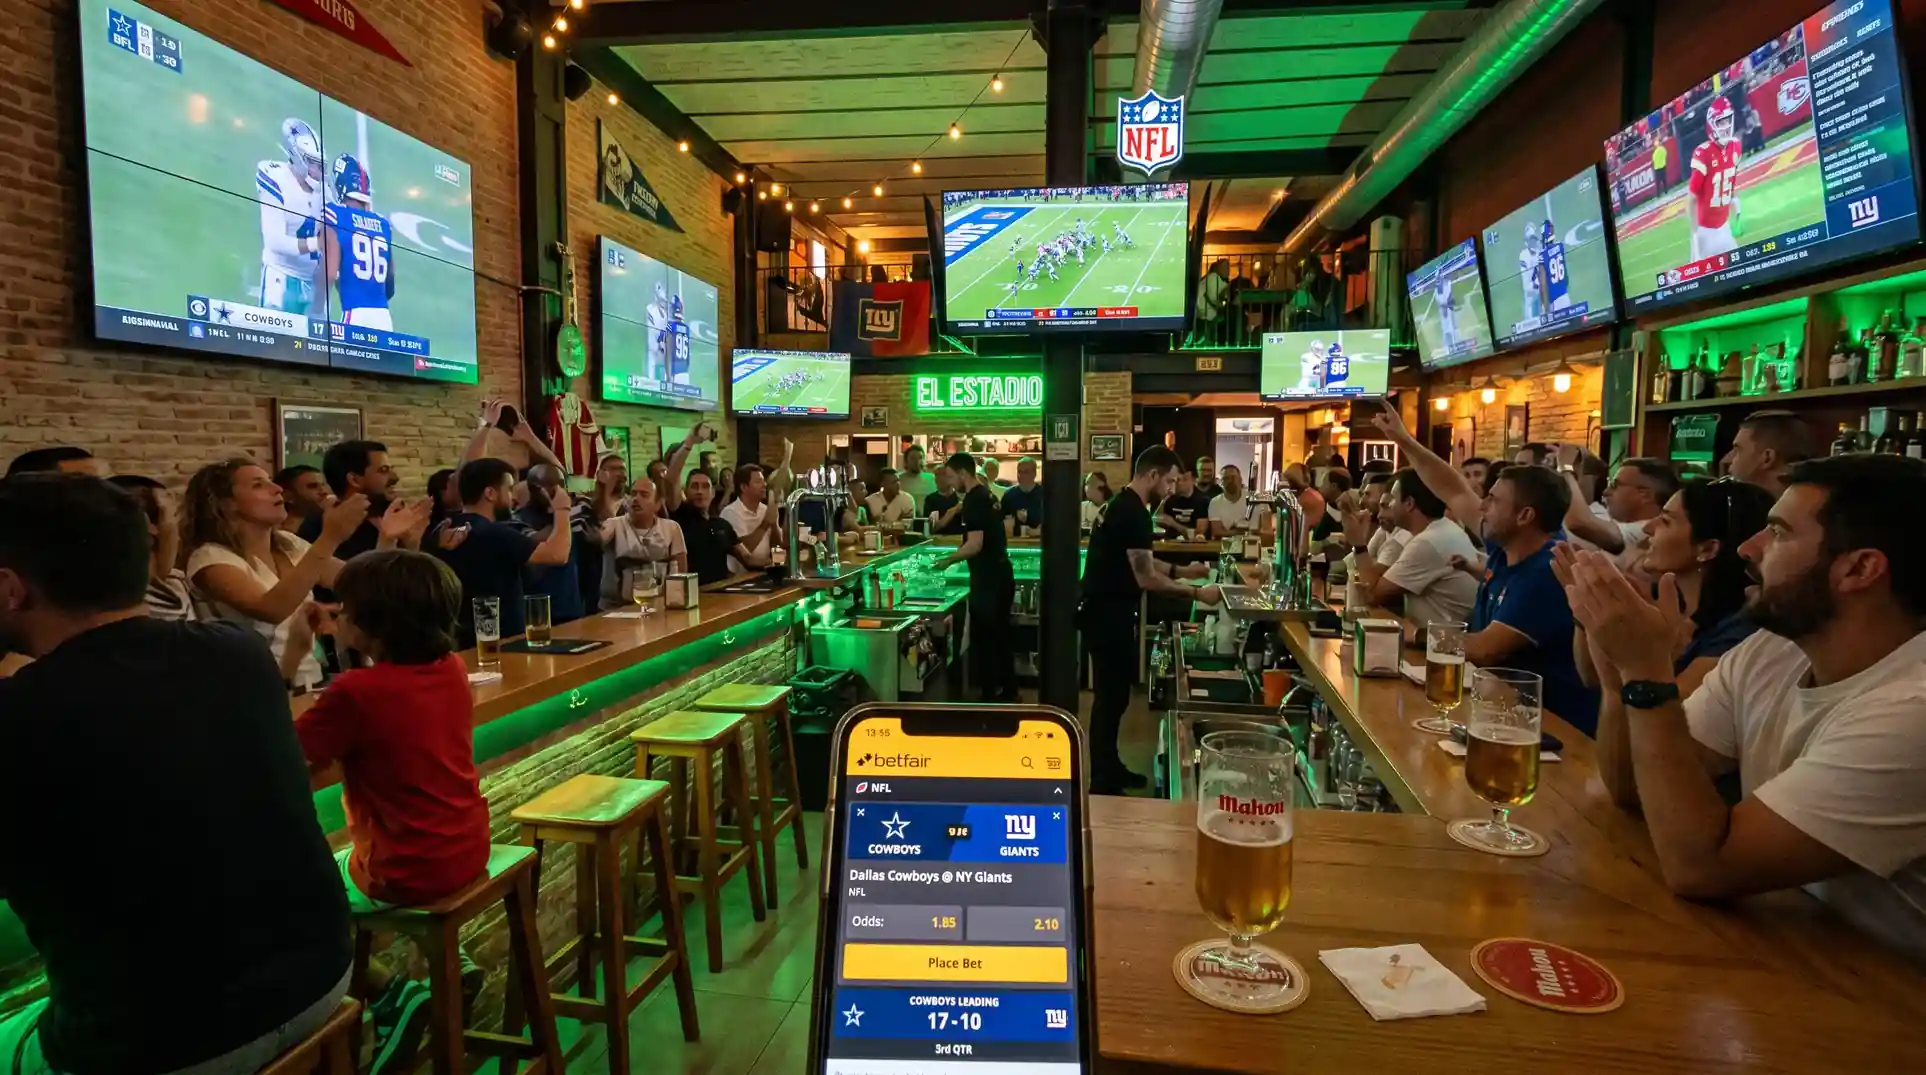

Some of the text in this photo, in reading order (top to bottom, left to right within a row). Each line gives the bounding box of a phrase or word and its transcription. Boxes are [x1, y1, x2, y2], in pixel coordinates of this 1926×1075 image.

[1125, 126, 1175, 162] NFL
[1709, 167, 1736, 207] 15
[352, 230, 389, 284] 96
[1550, 256, 1566, 284] 96
[244, 312, 294, 329] COWBOYS
[312, 322, 325, 336] 17
[675, 333, 689, 360] 96
[1330, 362, 1347, 376] 96
[917, 376, 1043, 407] EL ESTADIO
[874, 752, 931, 768] betfair
[871, 783, 891, 793] NFL
[868, 844, 921, 855] COWBOYS
[1000, 846, 1039, 857] GIANTS
[849, 870, 885, 882] Dallas
[888, 871, 940, 885] Cowboys
[942, 871, 953, 883] @
[955, 872, 973, 883] NY
[848, 887, 866, 897] NFL
[852, 916, 1059, 931] Odds: 1.85 2.10
[928, 957, 982, 969] Place Bet
[910, 996, 999, 1007] COWBOYS LEADING
[953, 1044, 972, 1056] QTR
